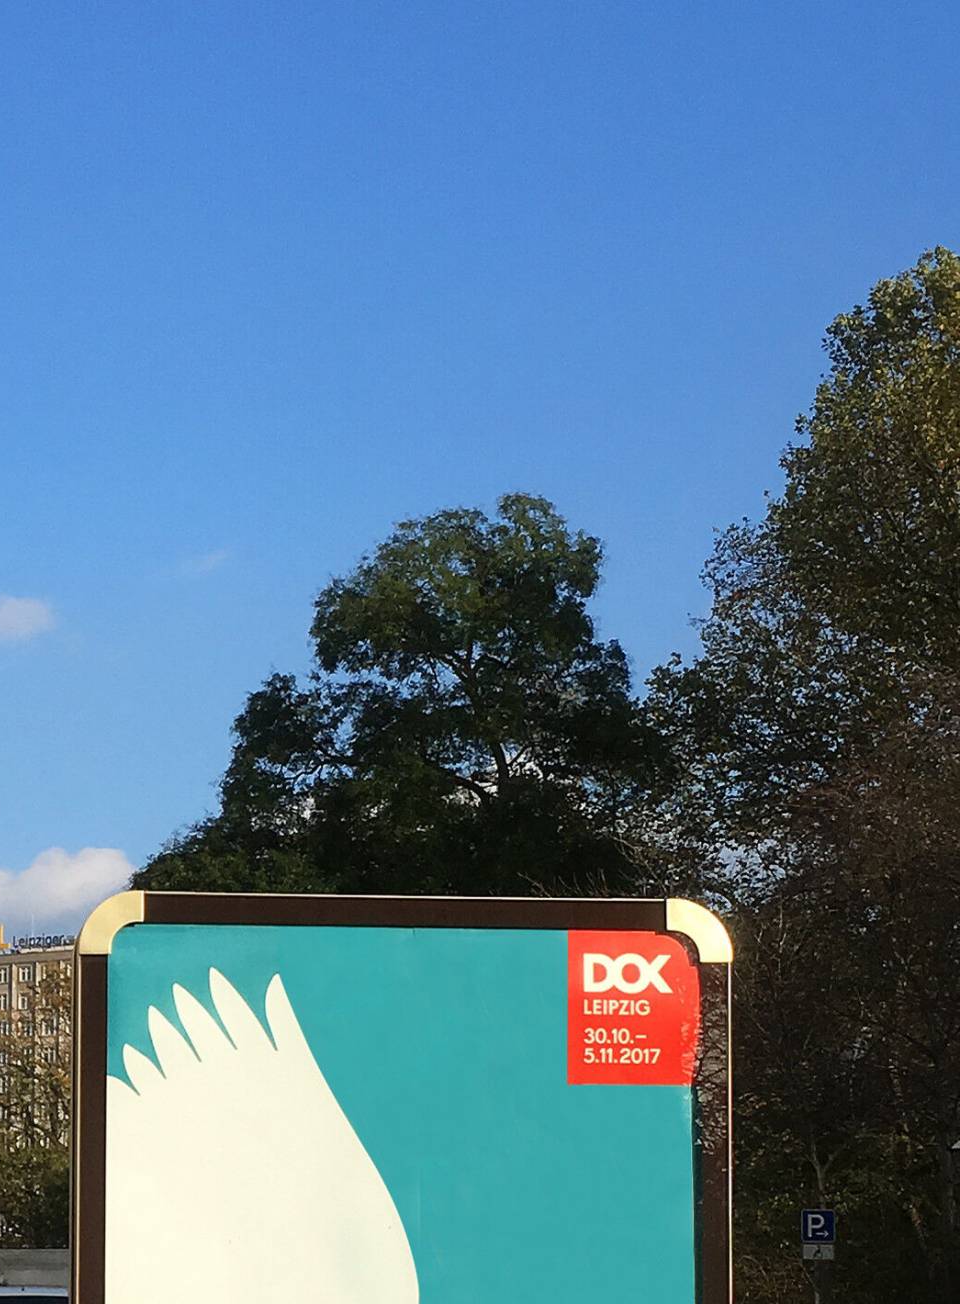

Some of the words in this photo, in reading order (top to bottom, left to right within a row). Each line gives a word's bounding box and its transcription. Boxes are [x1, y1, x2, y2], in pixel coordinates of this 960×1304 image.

[12, 933, 65, 949] Leipziger
[583, 999, 651, 1016] LEIPZIG
[583, 1047, 661, 1064] 5.11.2017
[807, 1214, 825, 1238] P
